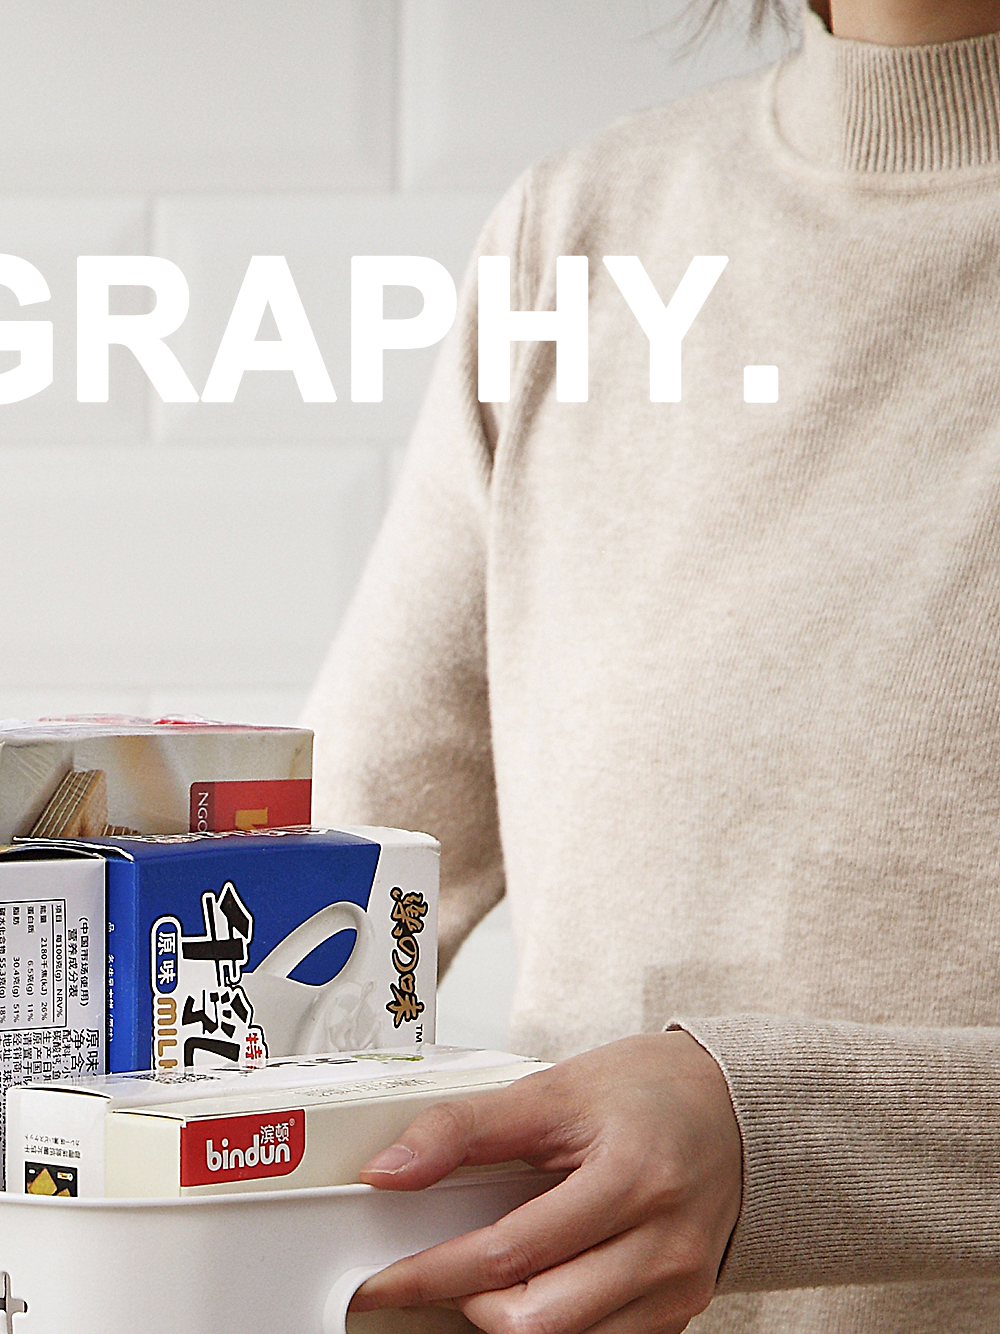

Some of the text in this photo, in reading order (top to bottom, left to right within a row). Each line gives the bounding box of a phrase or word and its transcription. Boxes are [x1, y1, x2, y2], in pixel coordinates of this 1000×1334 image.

[68, 928, 78, 998] 营养成分表
[79, 917, 89, 1007] (中国市场使用)
[157, 931, 176, 985] 原味
[71, 1029, 85, 1078] 净含
[205, 1134, 291, 1172] bindun
